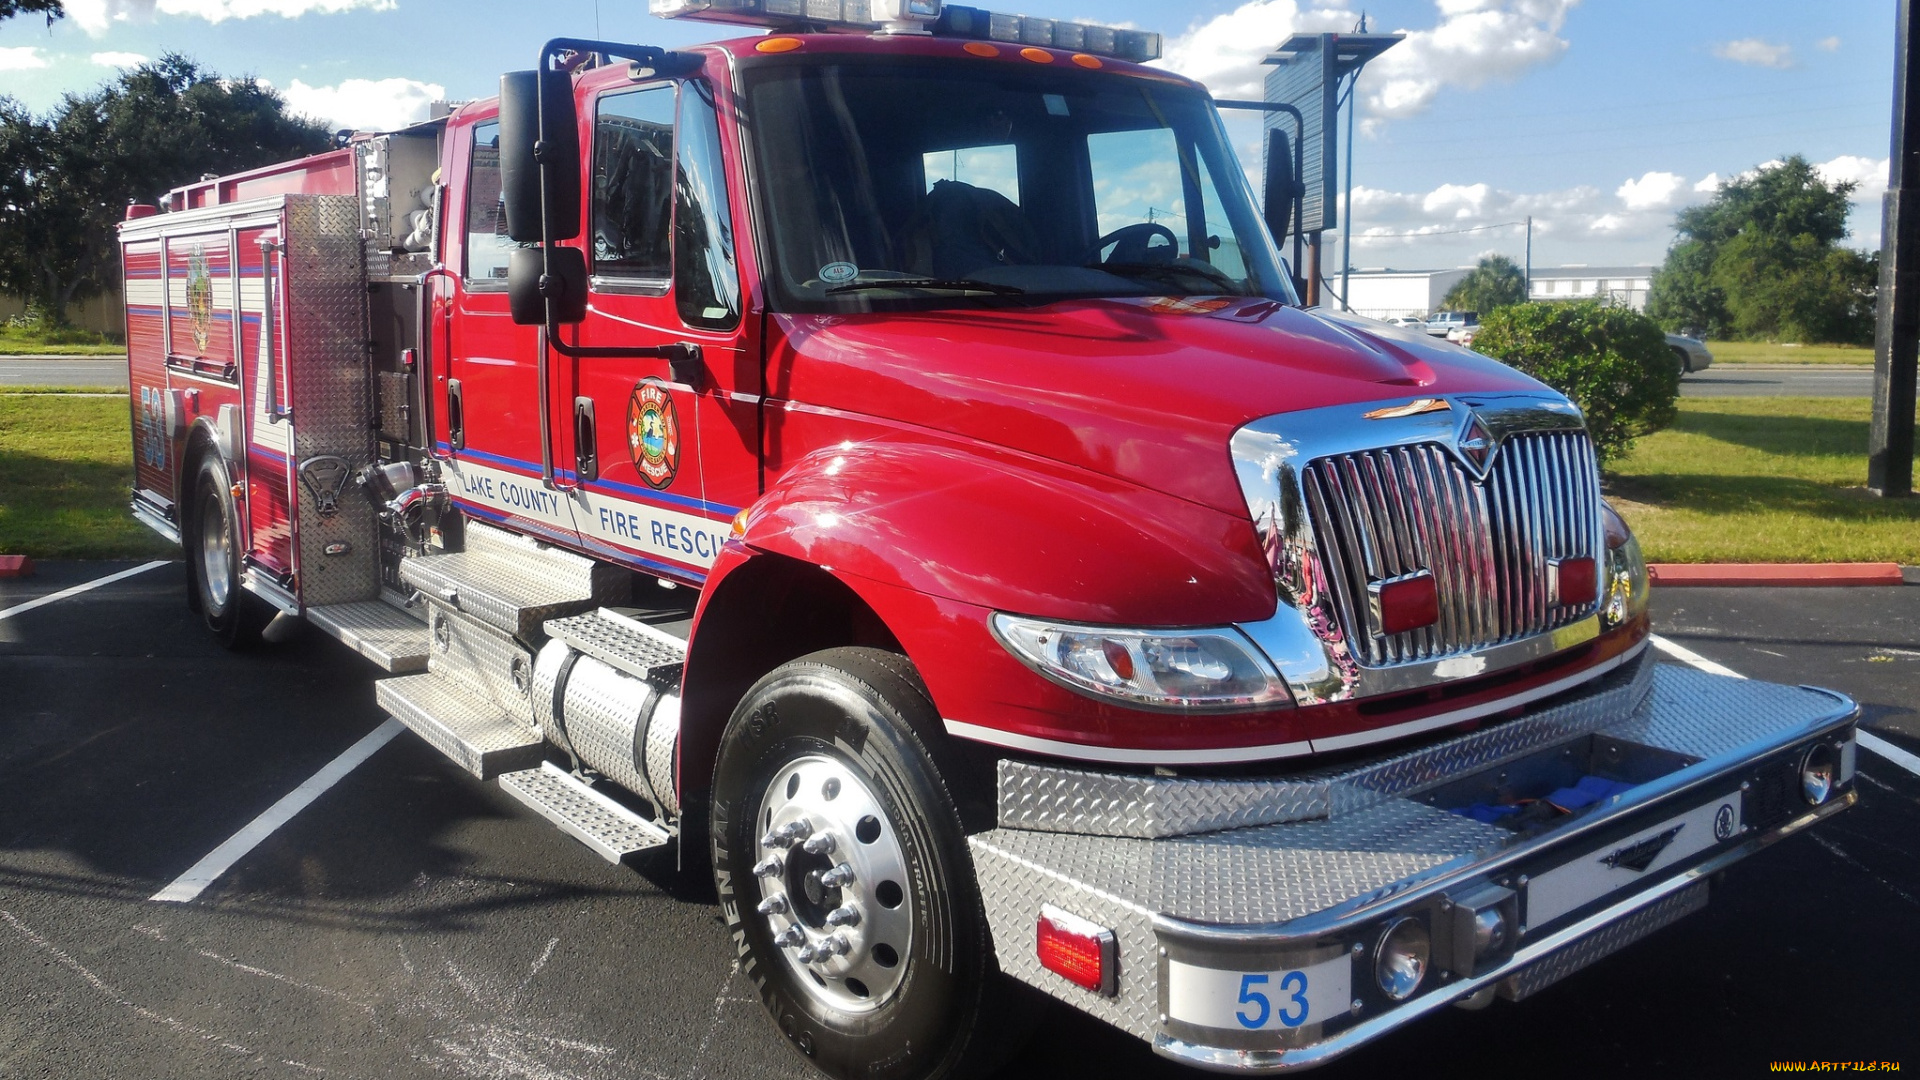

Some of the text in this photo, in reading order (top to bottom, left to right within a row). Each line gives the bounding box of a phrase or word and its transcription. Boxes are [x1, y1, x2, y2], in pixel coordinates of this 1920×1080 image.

[640, 387, 663, 404] FIRE
[140, 385, 166, 471] 53
[462, 471, 559, 517] LAKE COUNTY
[641, 460, 669, 477] RESCUE
[599, 507, 724, 558] FIRE RESCU
[713, 799, 816, 1058] CONTINENTAL
[1235, 970, 1310, 1030] 53
